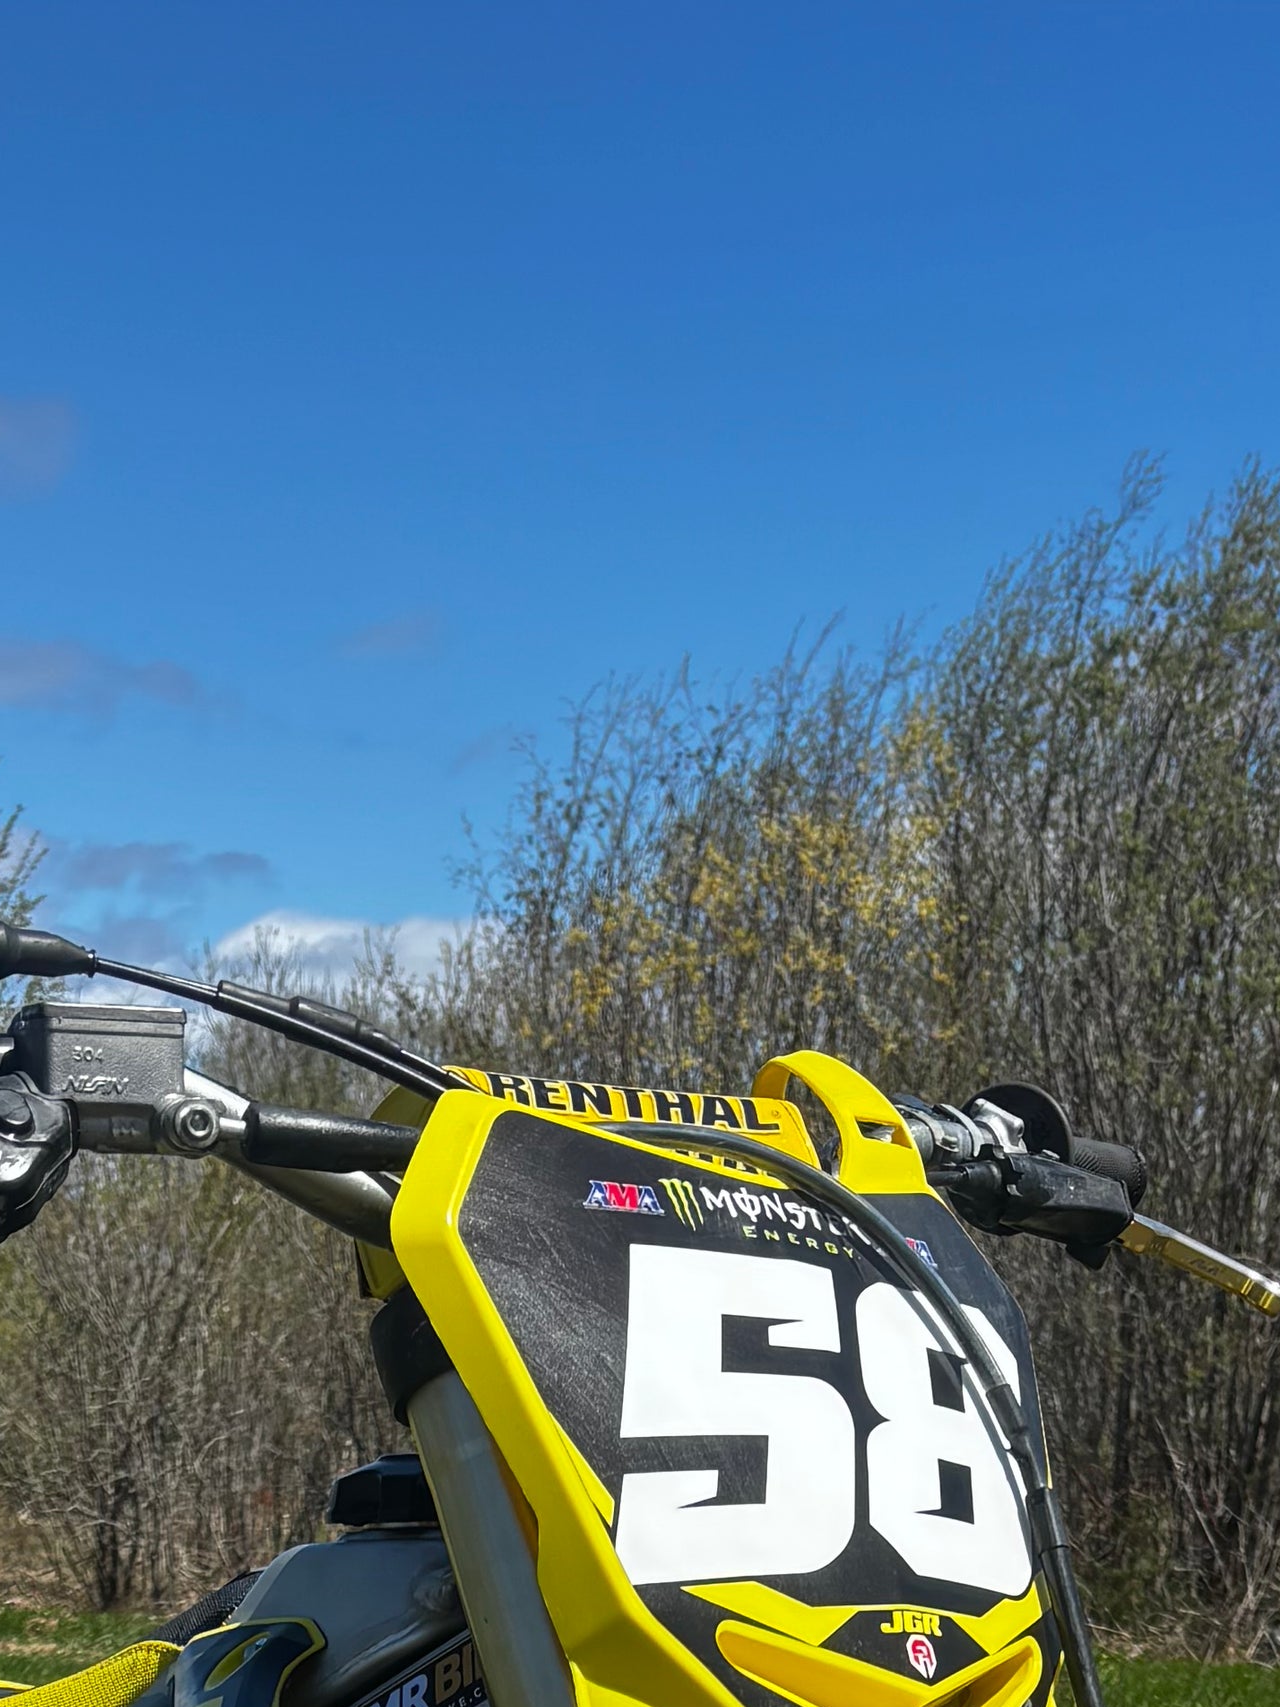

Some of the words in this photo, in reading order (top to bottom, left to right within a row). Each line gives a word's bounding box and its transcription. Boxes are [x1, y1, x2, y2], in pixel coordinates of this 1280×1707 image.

[486, 1072, 780, 1132] RENTHAL
[583, 1180, 665, 1216] AMA
[742, 1225, 857, 1259] ENERGY
[616, 1243, 1033, 1599] 58
[880, 1610, 942, 1637] JGR
